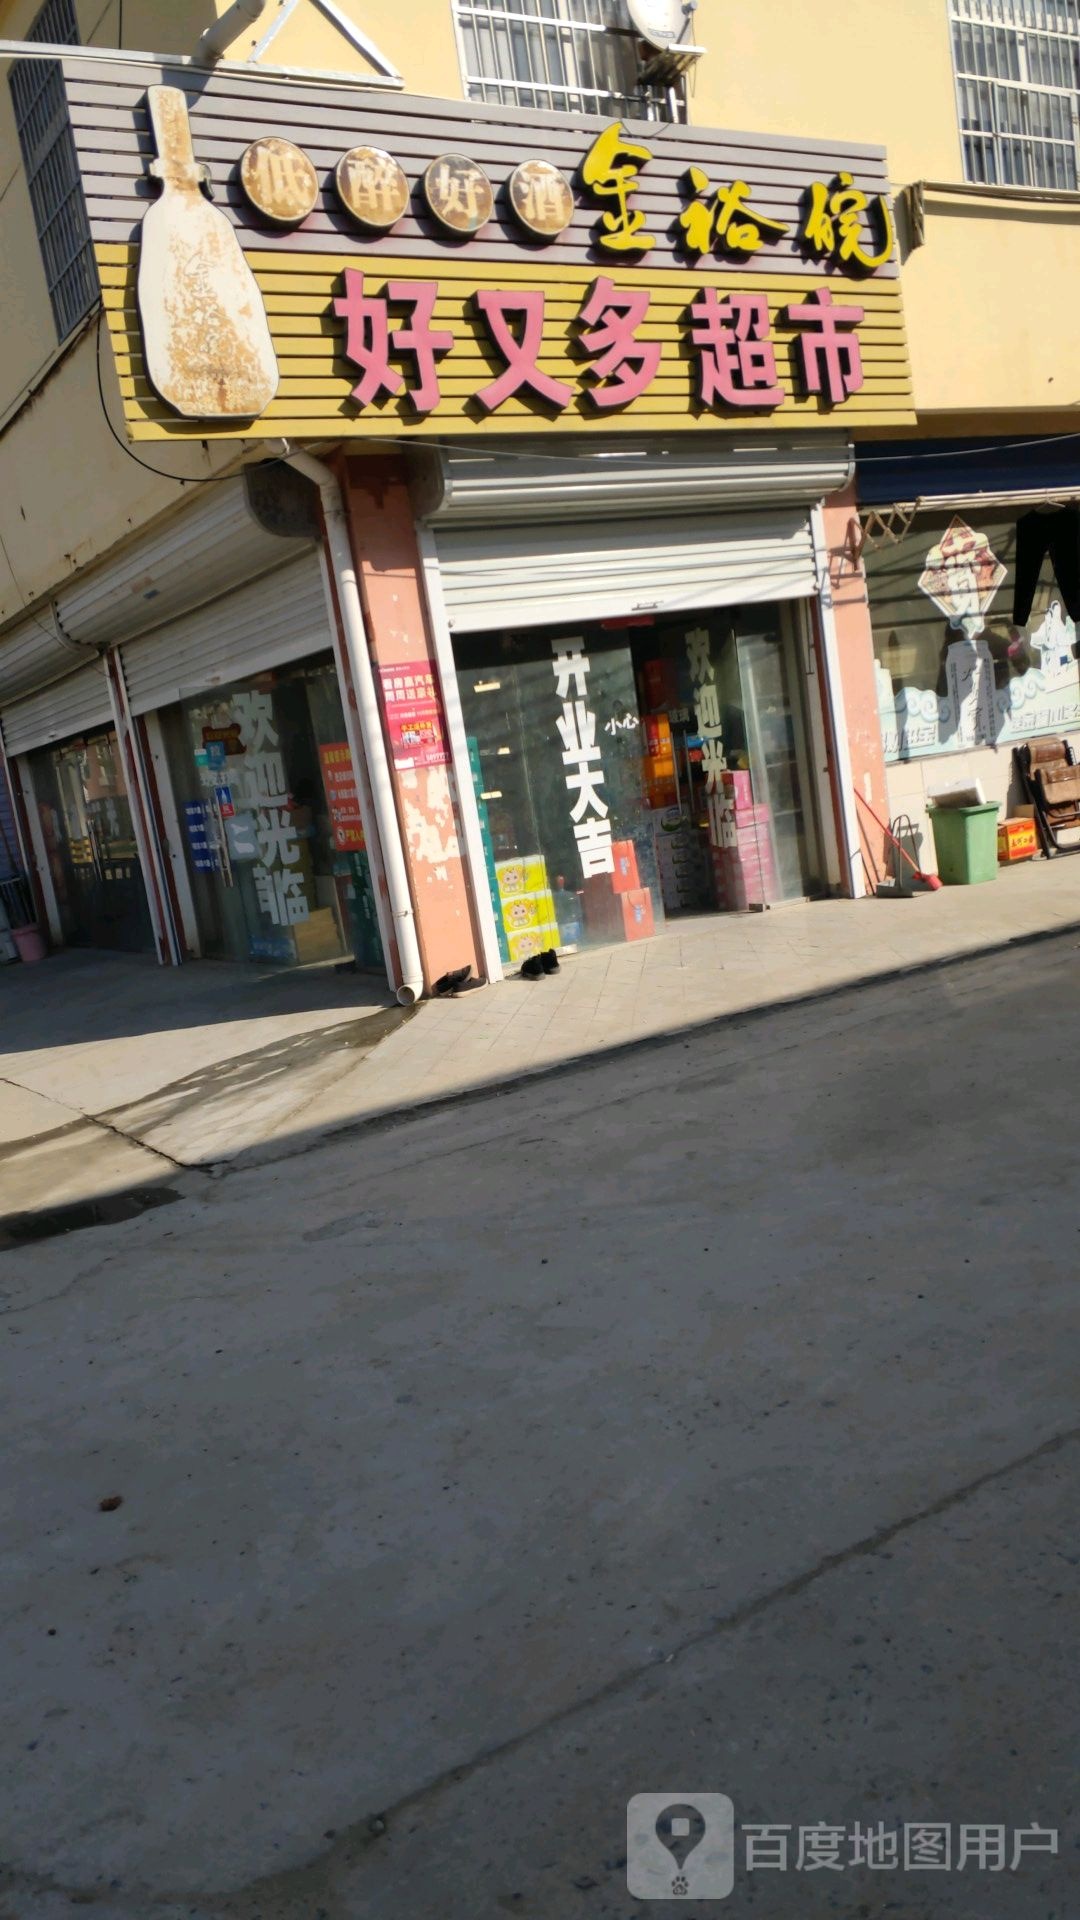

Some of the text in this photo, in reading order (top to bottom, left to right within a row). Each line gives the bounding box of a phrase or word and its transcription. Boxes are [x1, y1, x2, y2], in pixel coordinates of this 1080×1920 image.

[333, 268, 865, 412] 好又多超市
[551, 636, 616, 879] 开业大吉
[604, 713, 640, 736] 小心
[685, 627, 738, 849] 欢迎光临
